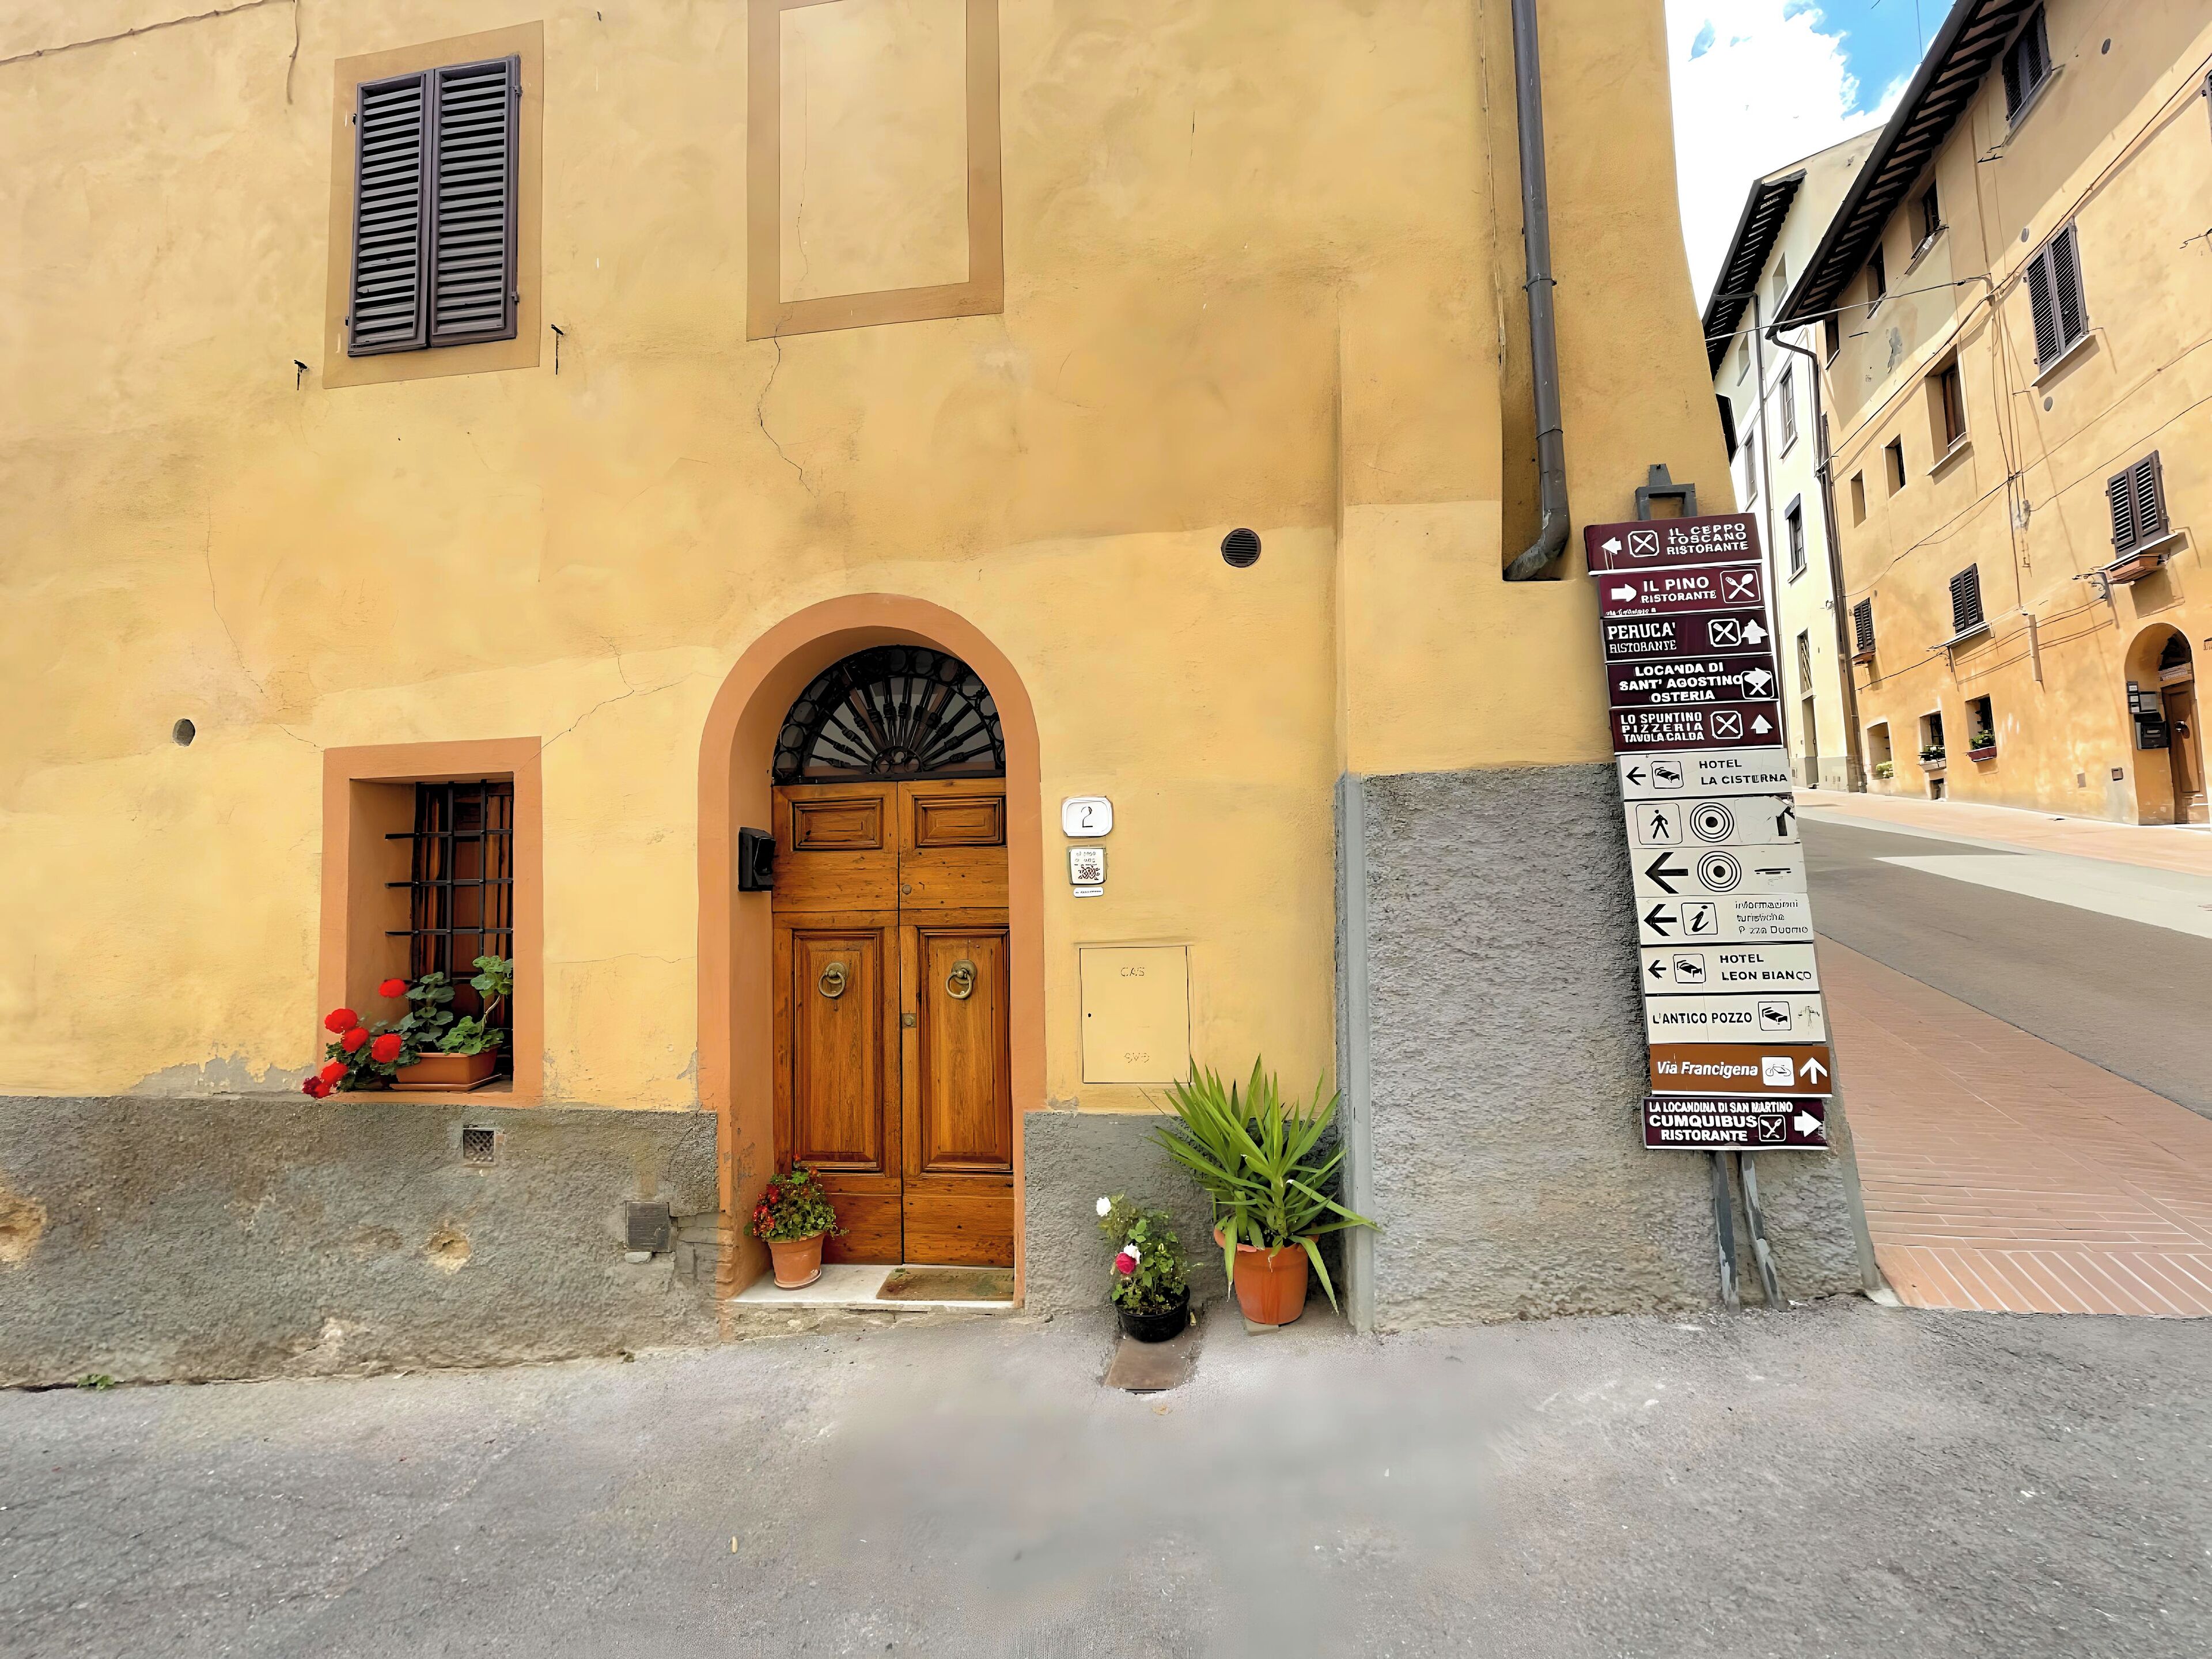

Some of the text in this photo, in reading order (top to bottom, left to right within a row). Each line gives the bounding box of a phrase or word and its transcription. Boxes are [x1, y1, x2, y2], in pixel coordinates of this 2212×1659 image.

[1669, 523, 1746, 536] IL CEPPO
[1667, 531, 1747, 545] TOSCANO
[1666, 541, 1749, 555] RISTORANTE
[1643, 577, 1709, 592] IL PINO
[1641, 590, 1717, 604] RISTORANTE
[1609, 639, 1677, 654] RISTORANTE
[1634, 662, 1724, 677] LOCANDA DI
[1618, 675, 1743, 691] SANT' AGOSTINO
[1650, 690, 1715, 703] OSTERIA
[1620, 711, 1702, 725] LO SPUNTINO
[1622, 722, 1704, 733] PIZZERIA
[1623, 732, 1705, 743] TAVOLA CALDA
[1699, 759, 1743, 769] HOTEL
[1700, 774, 1788, 785] LA CISTERNA
[1081, 806, 1093, 828] 2
[1719, 954, 1764, 964] HOTEL
[1721, 970, 1812, 981] LEON BIANCO
[1653, 1012, 1752, 1024] L'ANTICO POZZO
[1657, 1060, 1759, 1079] Via Francigena
[1649, 1101, 1793, 1113] LA LOCANDINA DI SAN MARTINO
[1649, 1115, 1758, 1128] CUMQUIBUS
[1661, 1129, 1748, 1142] RISTORANTE
